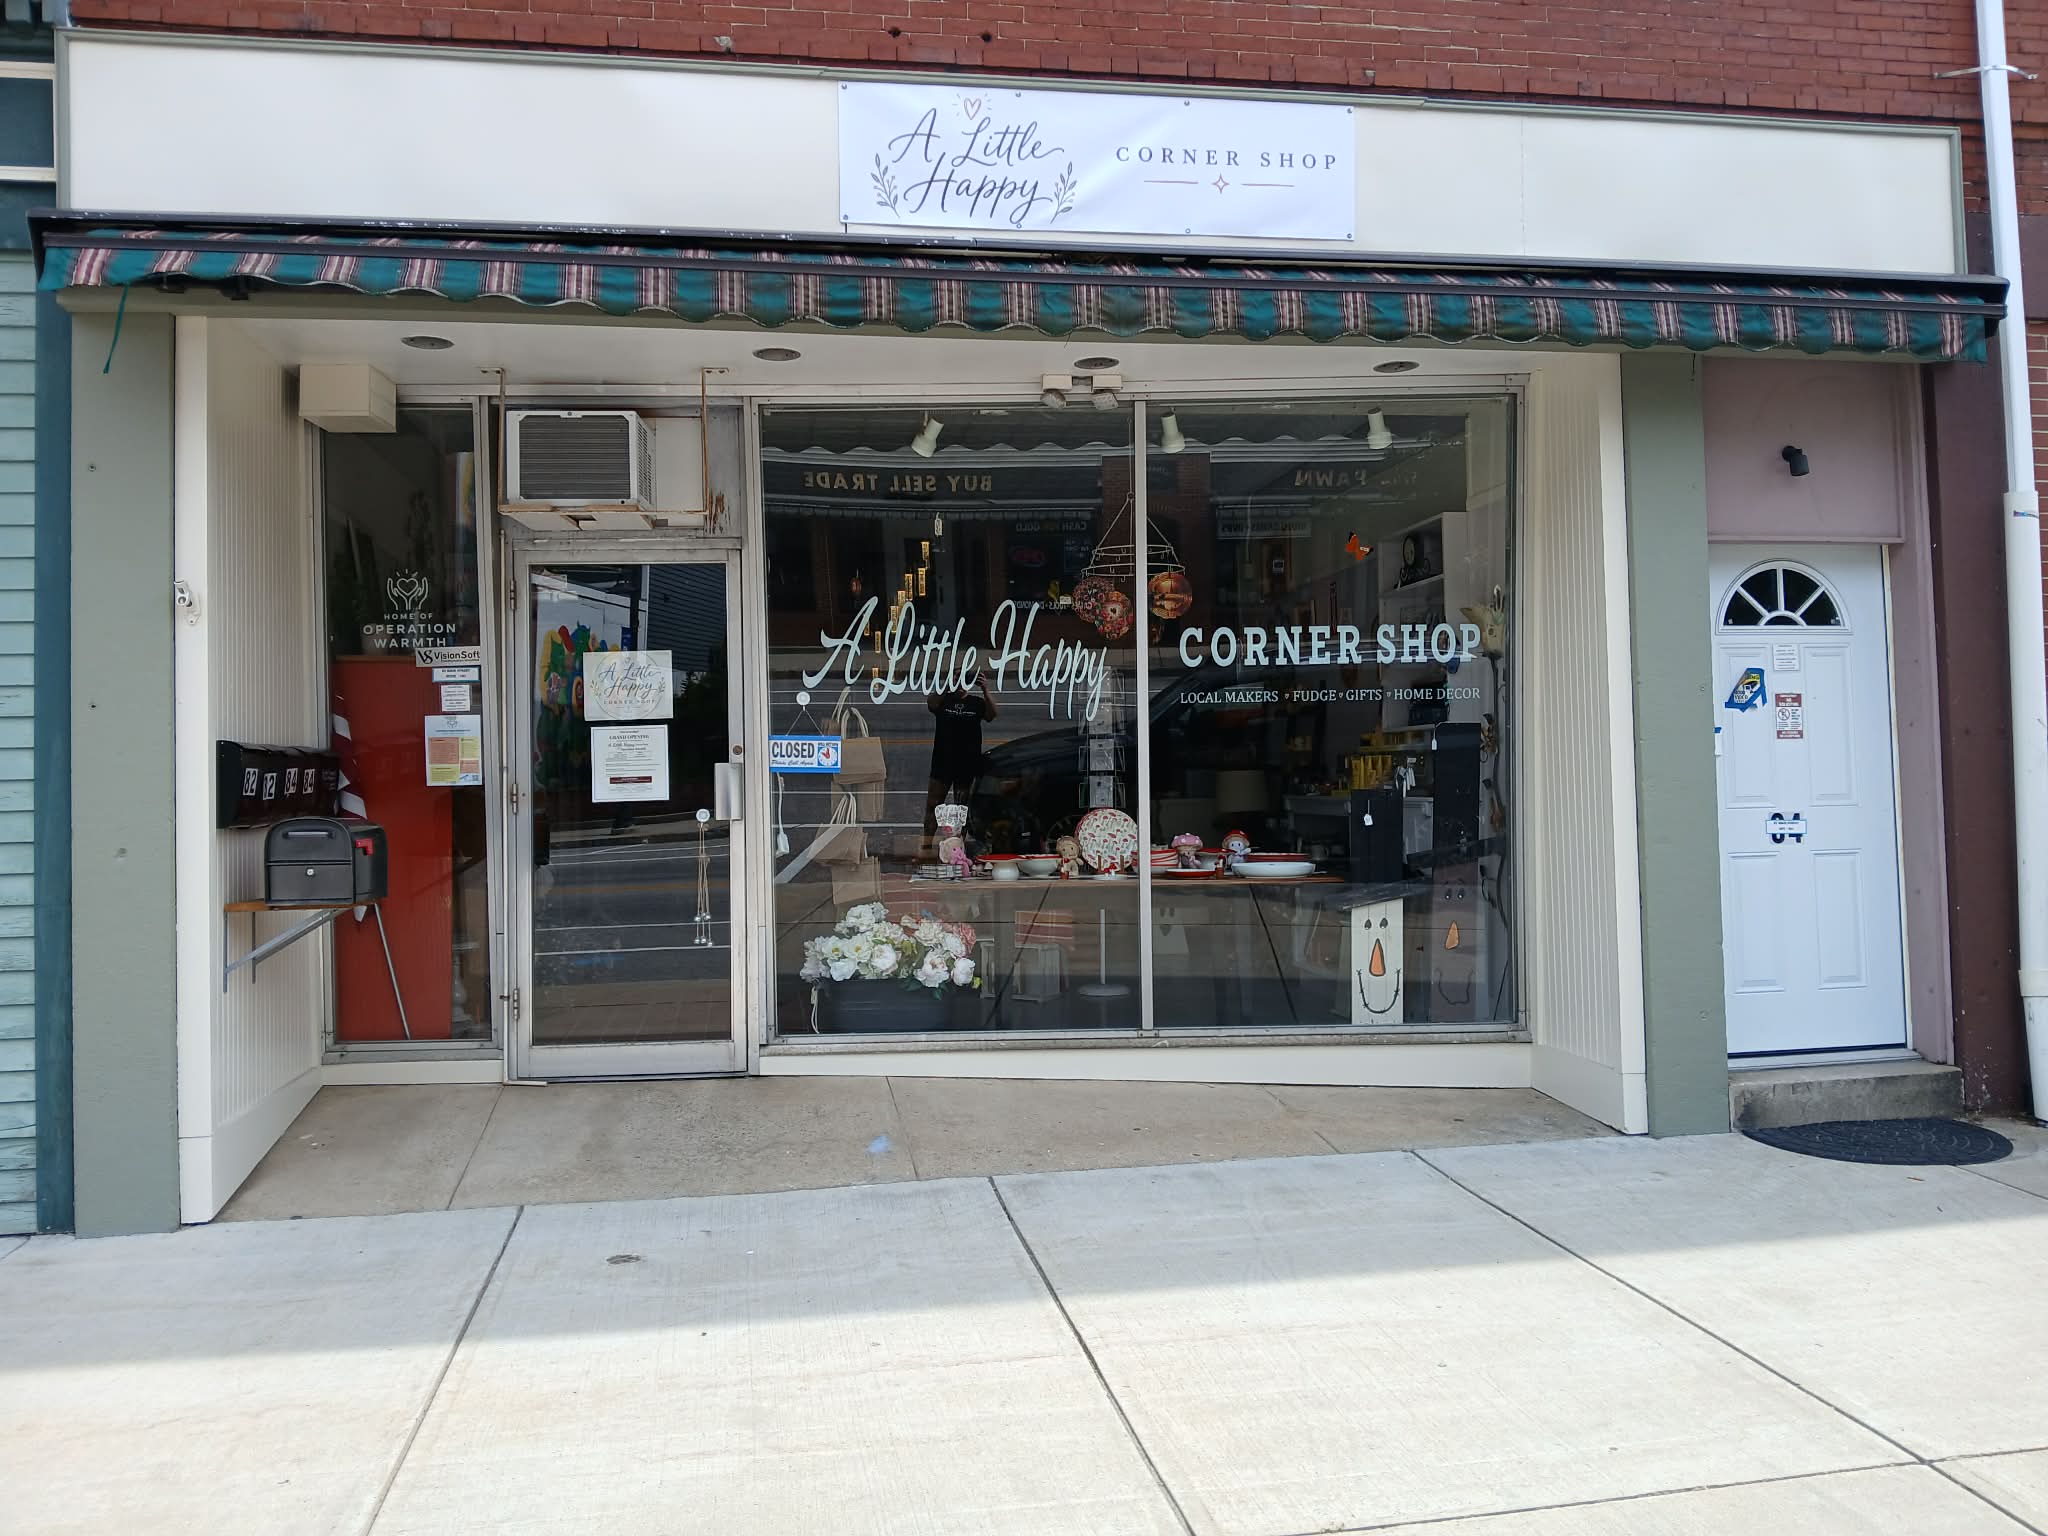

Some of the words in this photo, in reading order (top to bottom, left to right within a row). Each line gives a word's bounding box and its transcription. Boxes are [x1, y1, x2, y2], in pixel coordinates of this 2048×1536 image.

[888, 107, 941, 163] A
[951, 116, 1065, 168] Little
[1116, 145, 1241, 168] CORNER
[1259, 151, 1338, 170] SHOP
[903, 151, 1053, 225] Happy
[383, 612, 416, 620] HOME
[419, 612, 434, 620] OF
[362, 622, 457, 636] OPERATION
[374, 636, 447, 649] WARMTH
[1178, 625, 1363, 668] CORNER
[1375, 623, 1482, 666] SHOP
[434, 650, 481, 661] VisionSoft
[802, 595, 880, 689] A
[870, 601, 981, 705] Little
[988, 598, 1109, 722] Happy
[622, 662, 661, 682] Little
[604, 676, 658, 699] Happy
[1179, 692, 1223, 704] LOCAL
[1225, 690, 1279, 703] MAKERS
[1292, 688, 1337, 702] FUDGE
[1346, 688, 1382, 702] GIFTS
[1394, 687, 1434, 701] HOME
[1436, 687, 1481, 700] DECOR
[771, 742, 815, 759] CLOSED
[244, 770, 257, 795] 82
[286, 769, 297, 794] 84
[304, 770, 314, 794] 84
